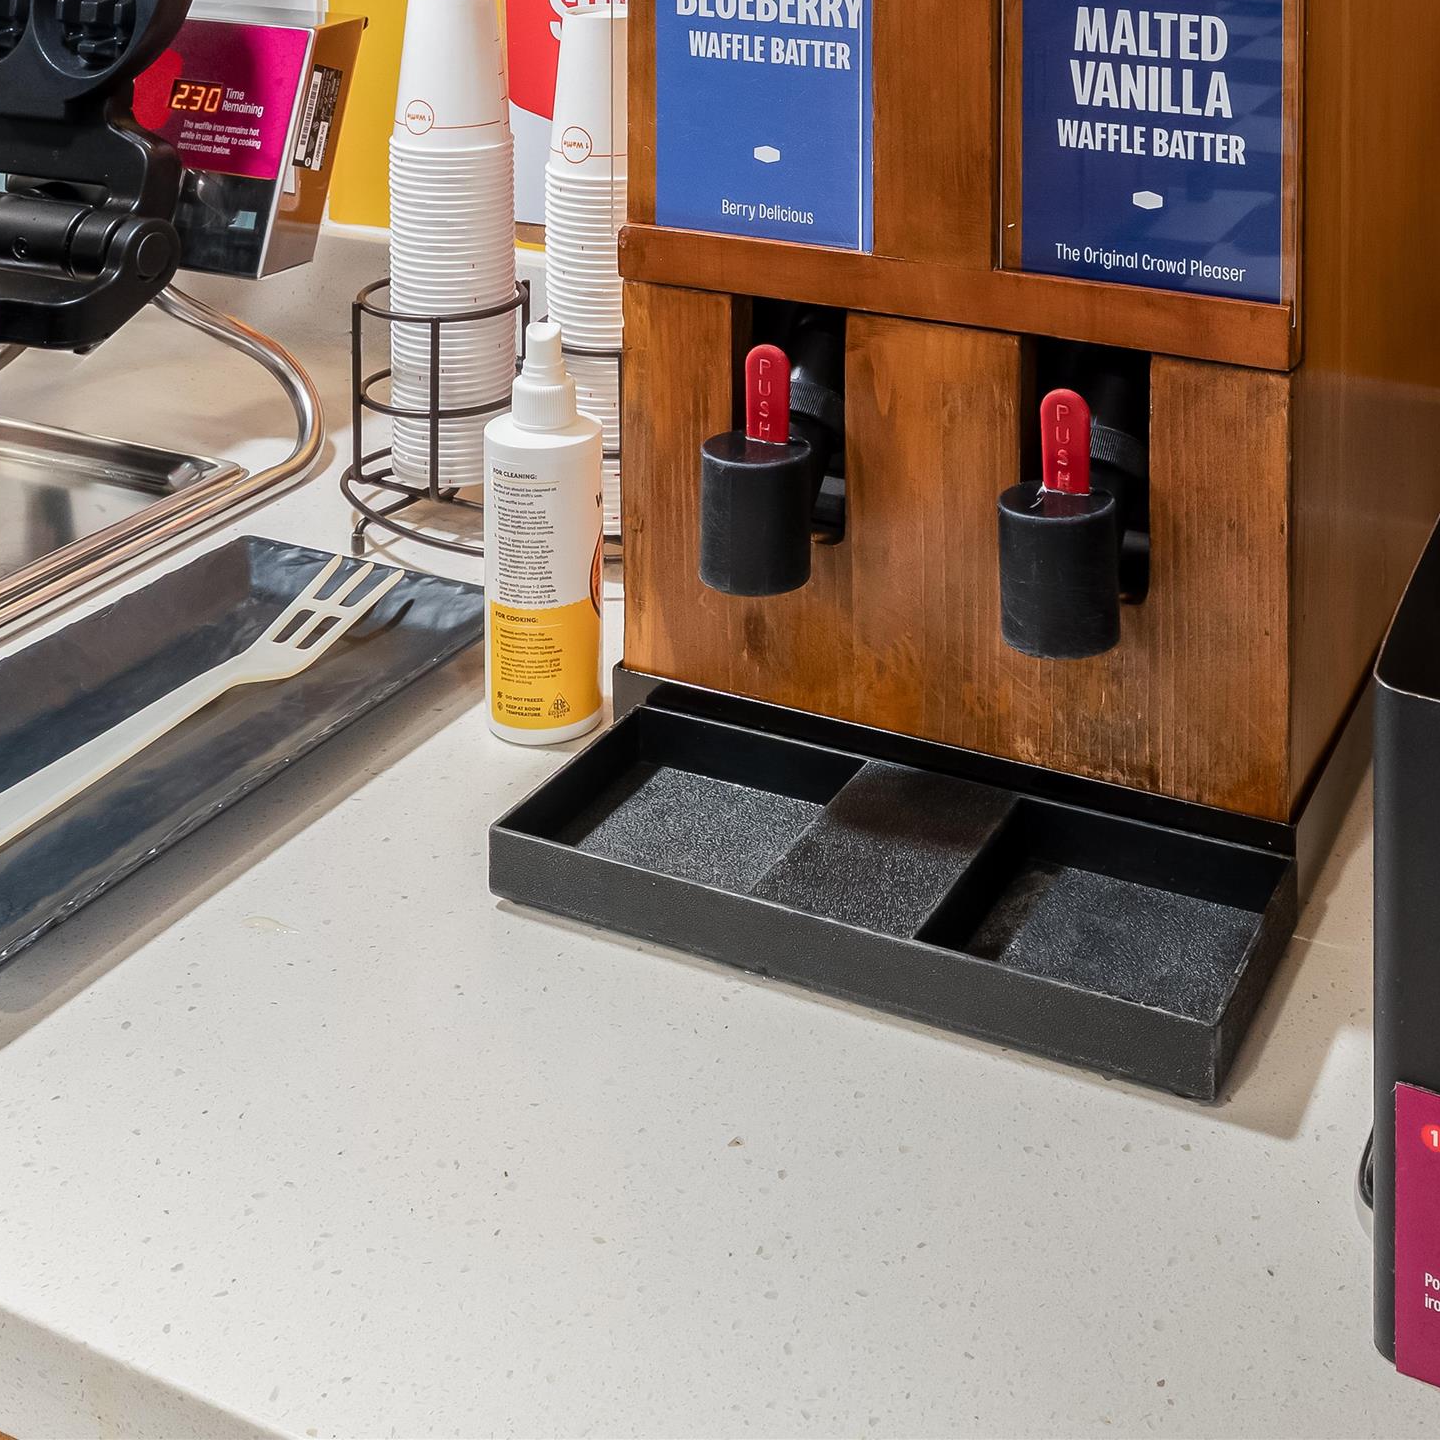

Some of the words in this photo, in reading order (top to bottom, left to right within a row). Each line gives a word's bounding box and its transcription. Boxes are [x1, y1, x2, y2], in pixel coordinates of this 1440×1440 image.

[688, 30, 766, 63] WAFFLE
[770, 36, 851, 70] BATTER
[1074, 6, 1228, 62] MALTED
[222, 100, 264, 117] Remaining
[226, 88, 245, 100] Time
[1069, 59, 1233, 119] VANILLA
[1057, 118, 1146, 156] WAFFLE
[1153, 127, 1246, 165] BATTER
[722, 199, 756, 221] Berry
[759, 203, 814, 225] Delicious
[1055, 242, 1080, 262] The
[1084, 246, 1138, 270] Original
[1142, 254, 1186, 276] Crowd
[1190, 260, 1246, 282] Pleaser
[758, 358, 771, 439] PUSH
[1055, 404, 1071, 489] PUSH
[503, 471, 538, 480] CLEANING:
[495, 610, 505, 619] FOR
[506, 614, 538, 623] COOKING:
[1429, 1129, 1440, 1148] 1
